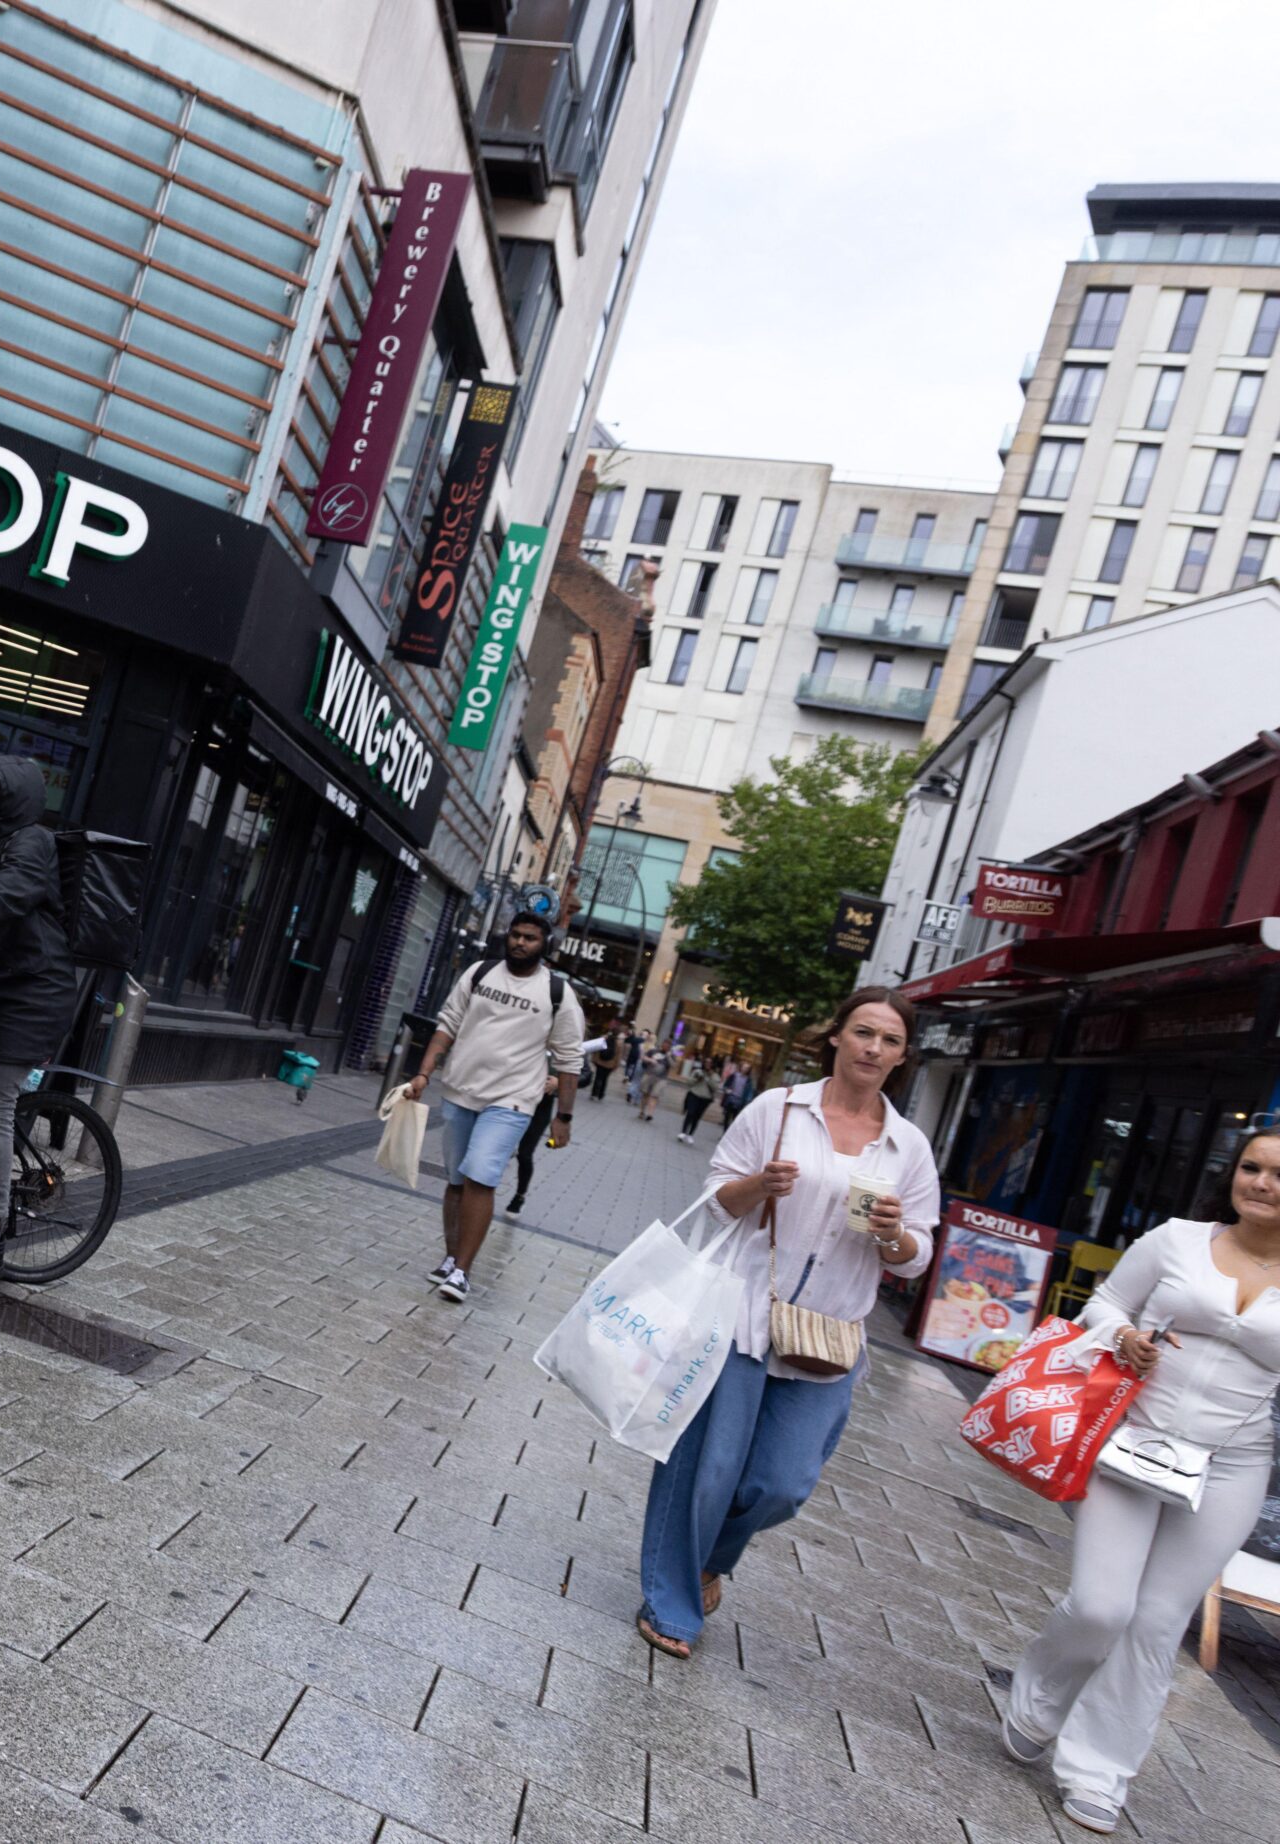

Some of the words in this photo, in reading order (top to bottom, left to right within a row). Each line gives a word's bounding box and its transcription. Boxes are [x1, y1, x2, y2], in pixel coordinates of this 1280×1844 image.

[391, 182, 443, 324] Brewery
[349, 335, 401, 473] Quarter
[452, 440, 498, 562] QUARTER
[983, 870, 1063, 898] TORTILLA
[923, 904, 961, 930] AFB
[559, 939, 608, 964] ATFACE
[471, 983, 532, 1011] NARUTO
[962, 1208, 1041, 1244] TORTILLA
[588, 1281, 664, 1346] MARK
